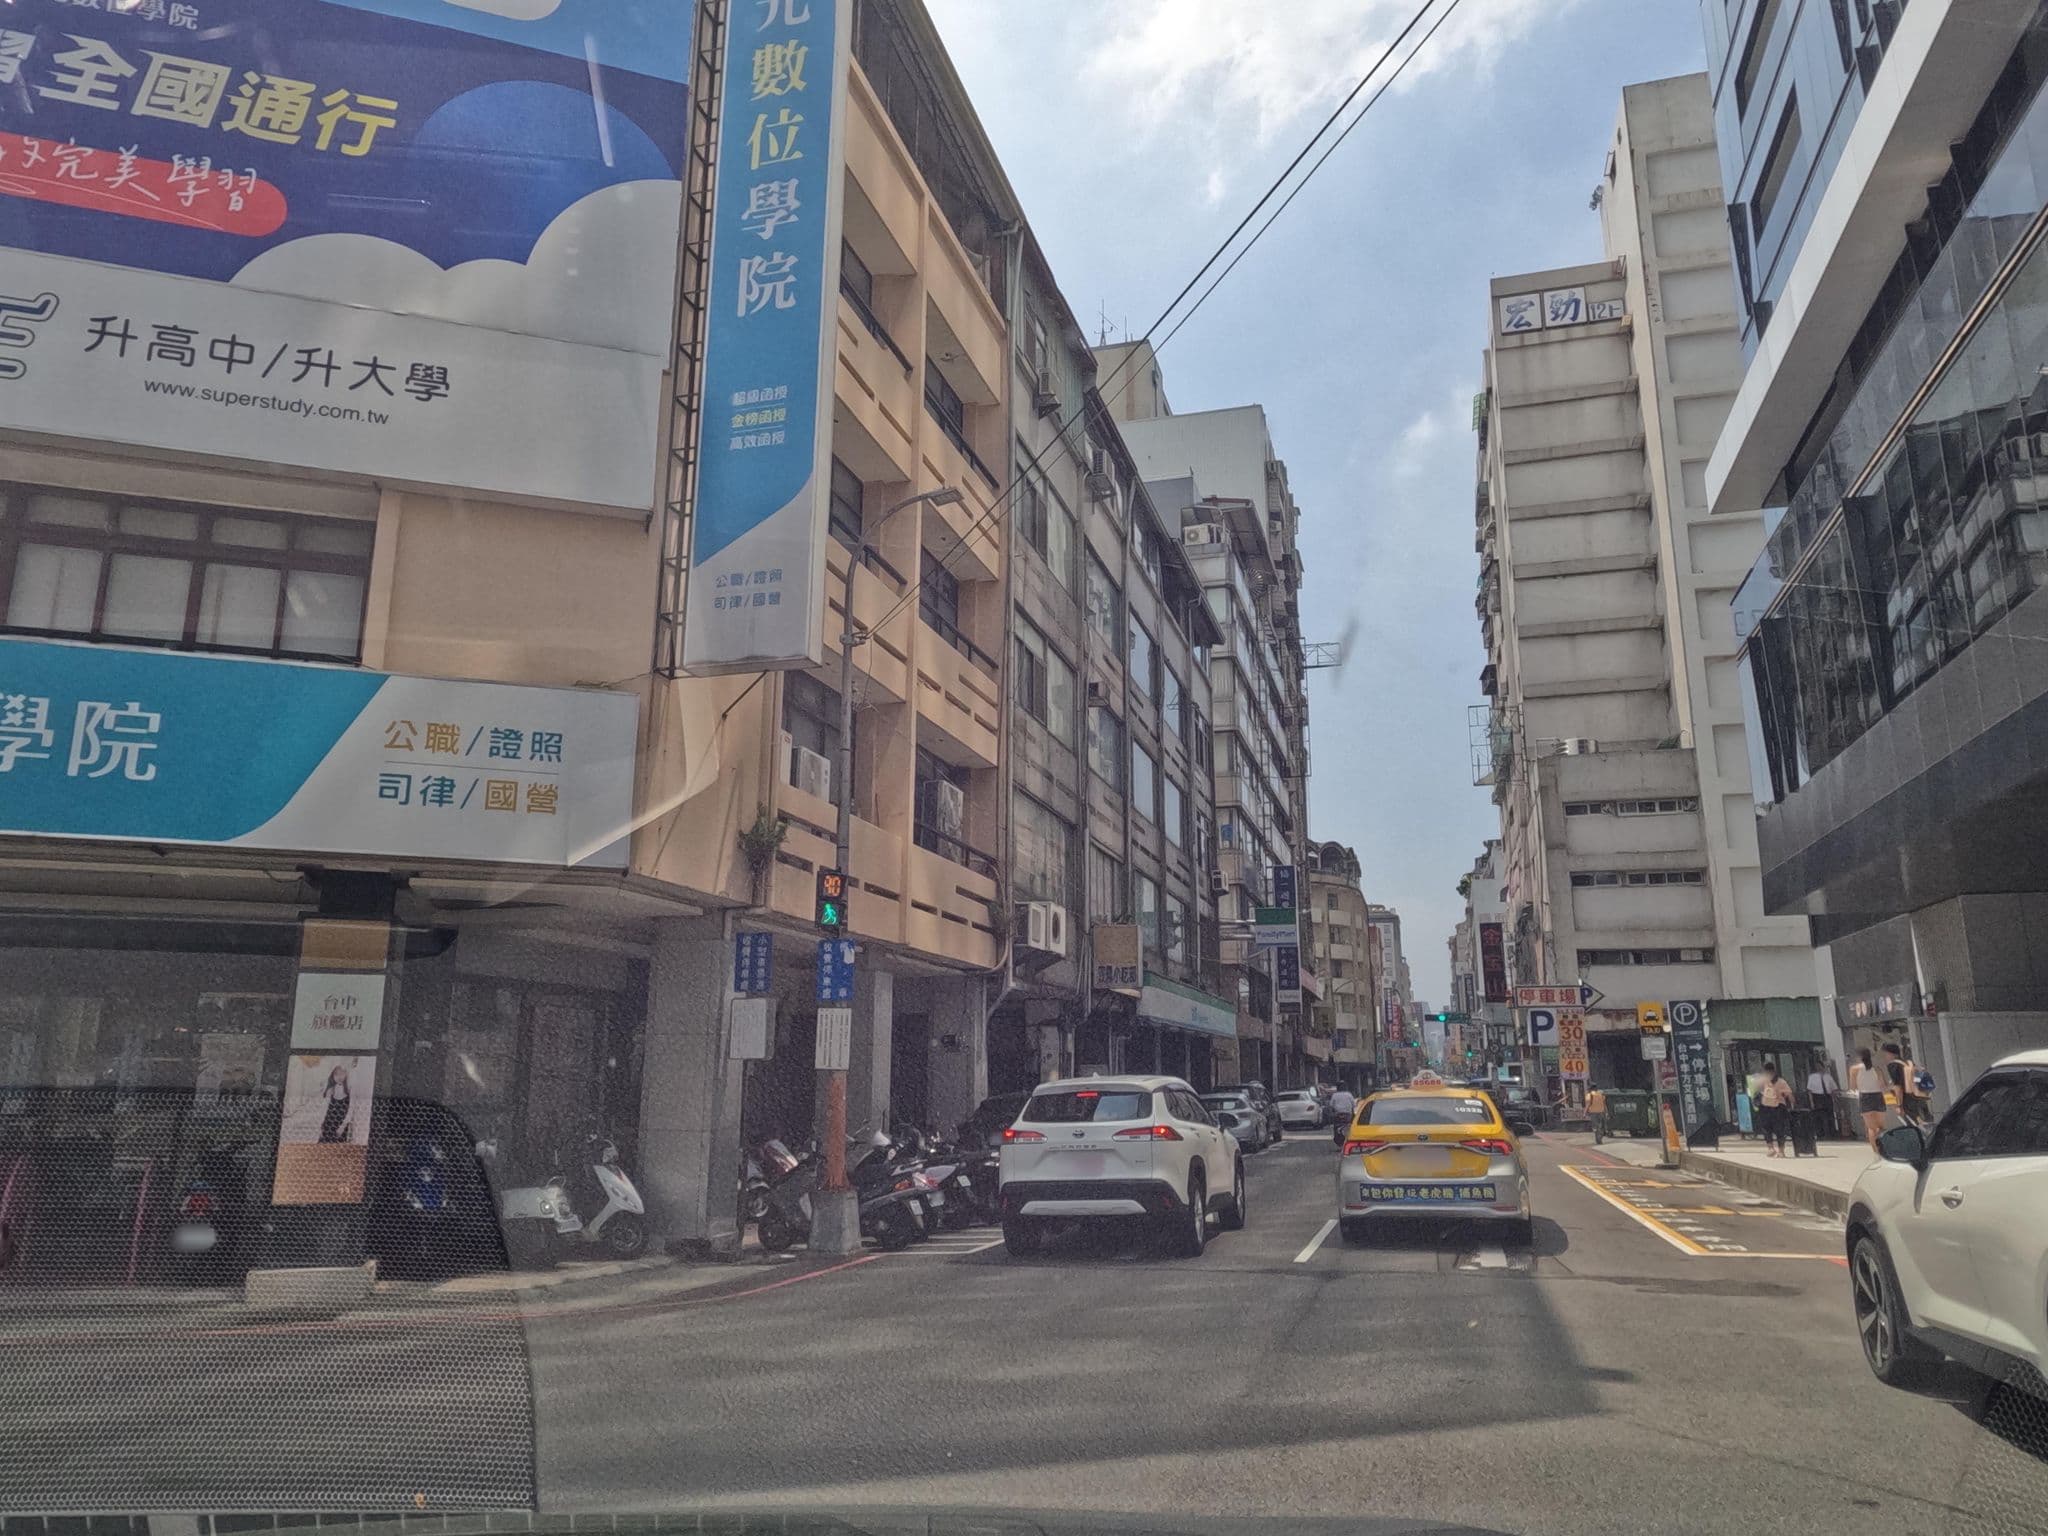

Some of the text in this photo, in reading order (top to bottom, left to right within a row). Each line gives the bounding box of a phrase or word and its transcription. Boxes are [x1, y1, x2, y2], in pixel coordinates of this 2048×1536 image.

[85, 315, 450, 402] 升高中/升大學
[144, 376, 390, 425] www.superstudy.com.tw
[383, 718, 564, 764] 公職/證照
[378, 772, 559, 816] 司律/國營
[1519, 988, 1577, 1005] 停車場
[1529, 1009, 1555, 1045] P
[1561, 1026, 1584, 1040] 30
[1565, 1061, 1584, 1073] 40
